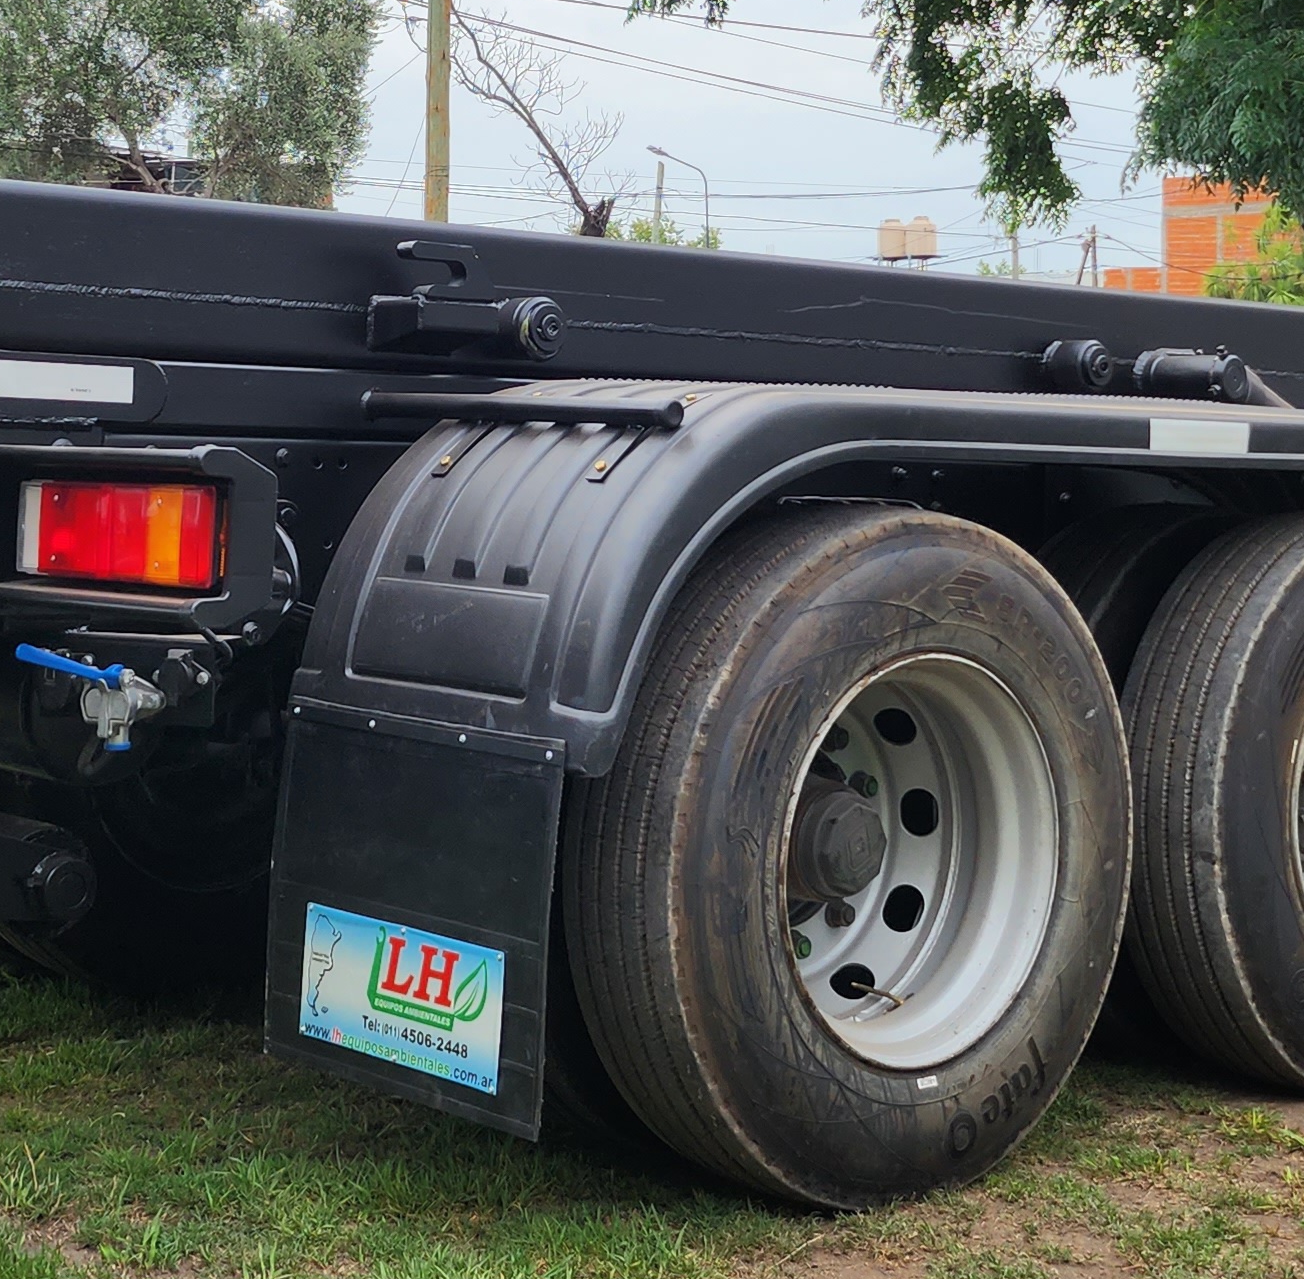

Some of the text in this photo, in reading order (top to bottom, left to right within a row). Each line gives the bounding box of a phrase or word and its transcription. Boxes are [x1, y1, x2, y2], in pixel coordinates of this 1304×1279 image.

[380, 936, 460, 1008] LH
[362, 1015, 381, 1034] Tel:
[400, 1027, 469, 1059] 4506-2448
[374, 997, 451, 1026] EQUIPOS AMBIENTALES
[304, 1021, 493, 1089] www.lhequiposambientales.com.ar
